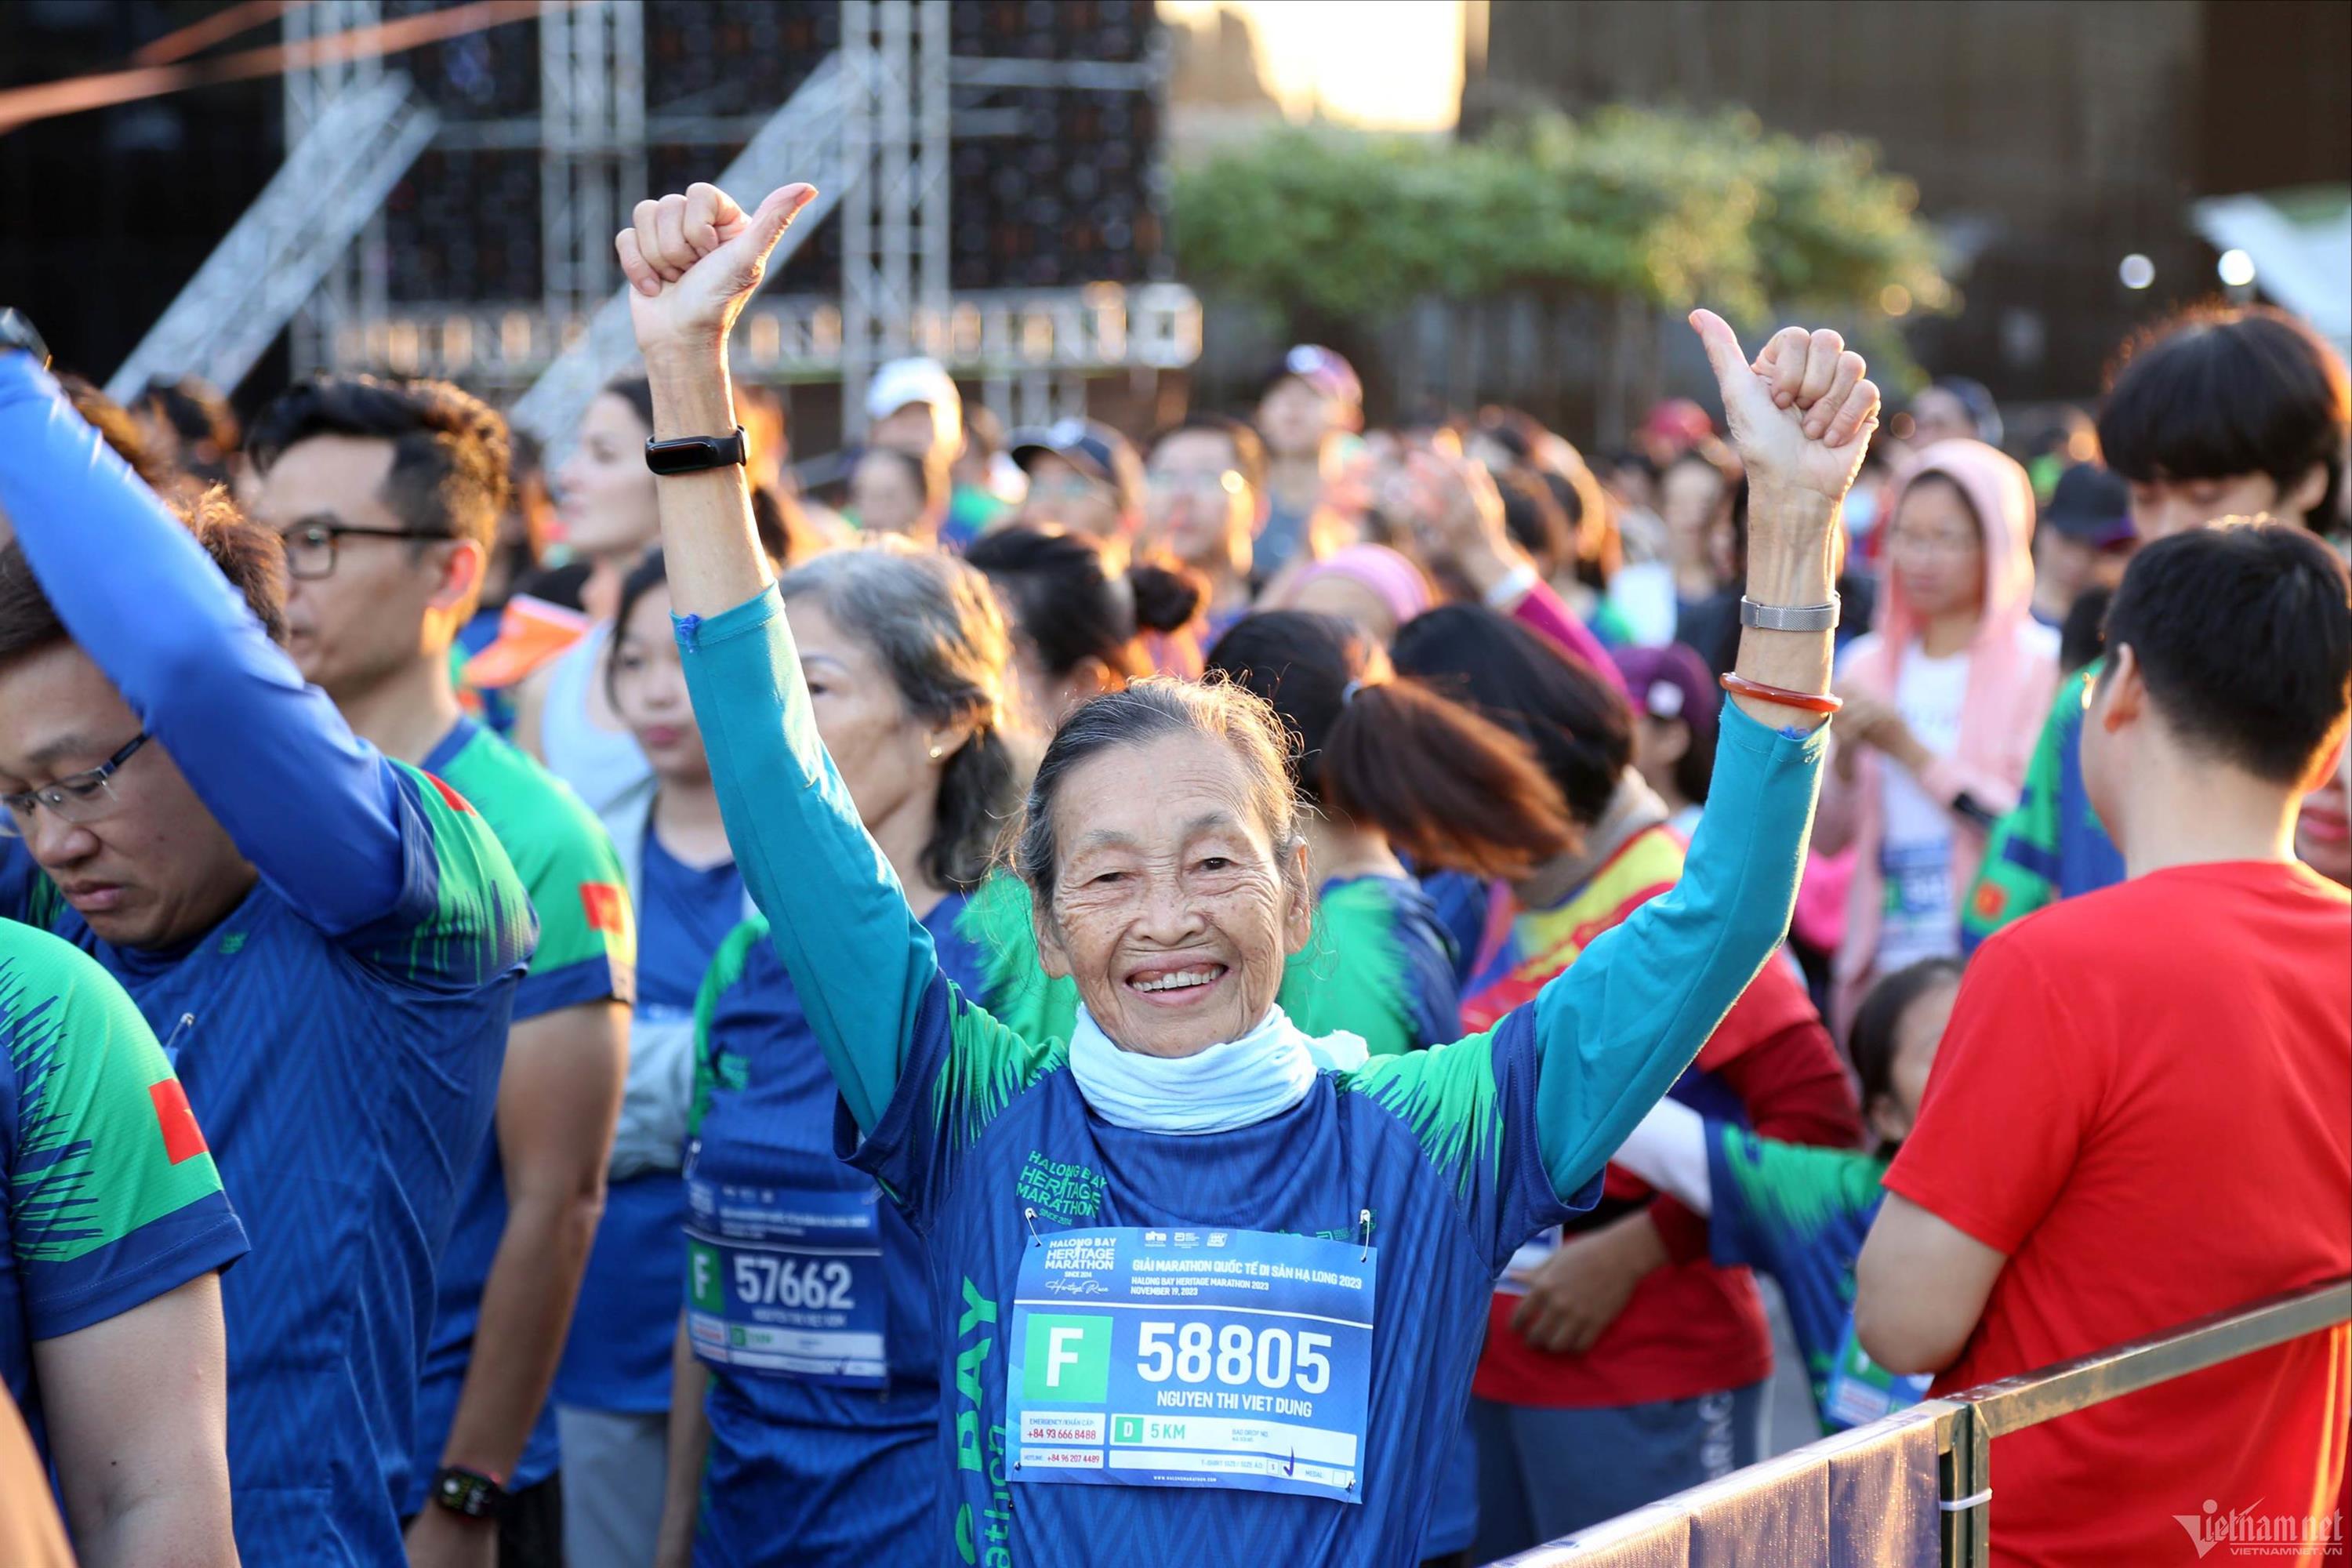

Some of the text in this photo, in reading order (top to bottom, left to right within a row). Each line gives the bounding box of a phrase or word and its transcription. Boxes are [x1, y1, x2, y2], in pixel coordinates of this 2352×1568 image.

[1028, 1150, 1108, 1189] HALONG BAY
[1020, 1165, 1102, 1210] HERITAGE
[1016, 1182, 1096, 1219] MARATHON
[1047, 1246, 1116, 1261] HERITAGE
[1049, 1237, 1117, 1248] HALONG BAY
[1044, 1259, 1114, 1271] MARATHON
[1132, 1258, 1363, 1290] GIẢI MARATHON QUỐC TẾ DI SẢN HẠ LONG 2023
[692, 1252, 855, 1310] F 57662
[1130, 1286, 1171, 1296] NOVEMBER
[1181, 1287, 1199, 1296] 2023
[1131, 1276, 1270, 1291] HALONG BAY HERITAGE MARATHON 2023
[1047, 1321, 1333, 1395] F 58805
[956, 1274, 997, 1472] BAY
[1156, 1390, 1313, 1417] NGUYEN THI VIET DUNG
[1027, 1428, 1097, 1441] +84 93 666 8488
[1123, 1421, 1186, 1440] D 5 KM
[1047, 1454, 1060, 1462] +84
[1061, 1454, 1069, 1463] 96
[1069, 1454, 1082, 1464] 207
[1083, 1454, 1101, 1465] 4489
